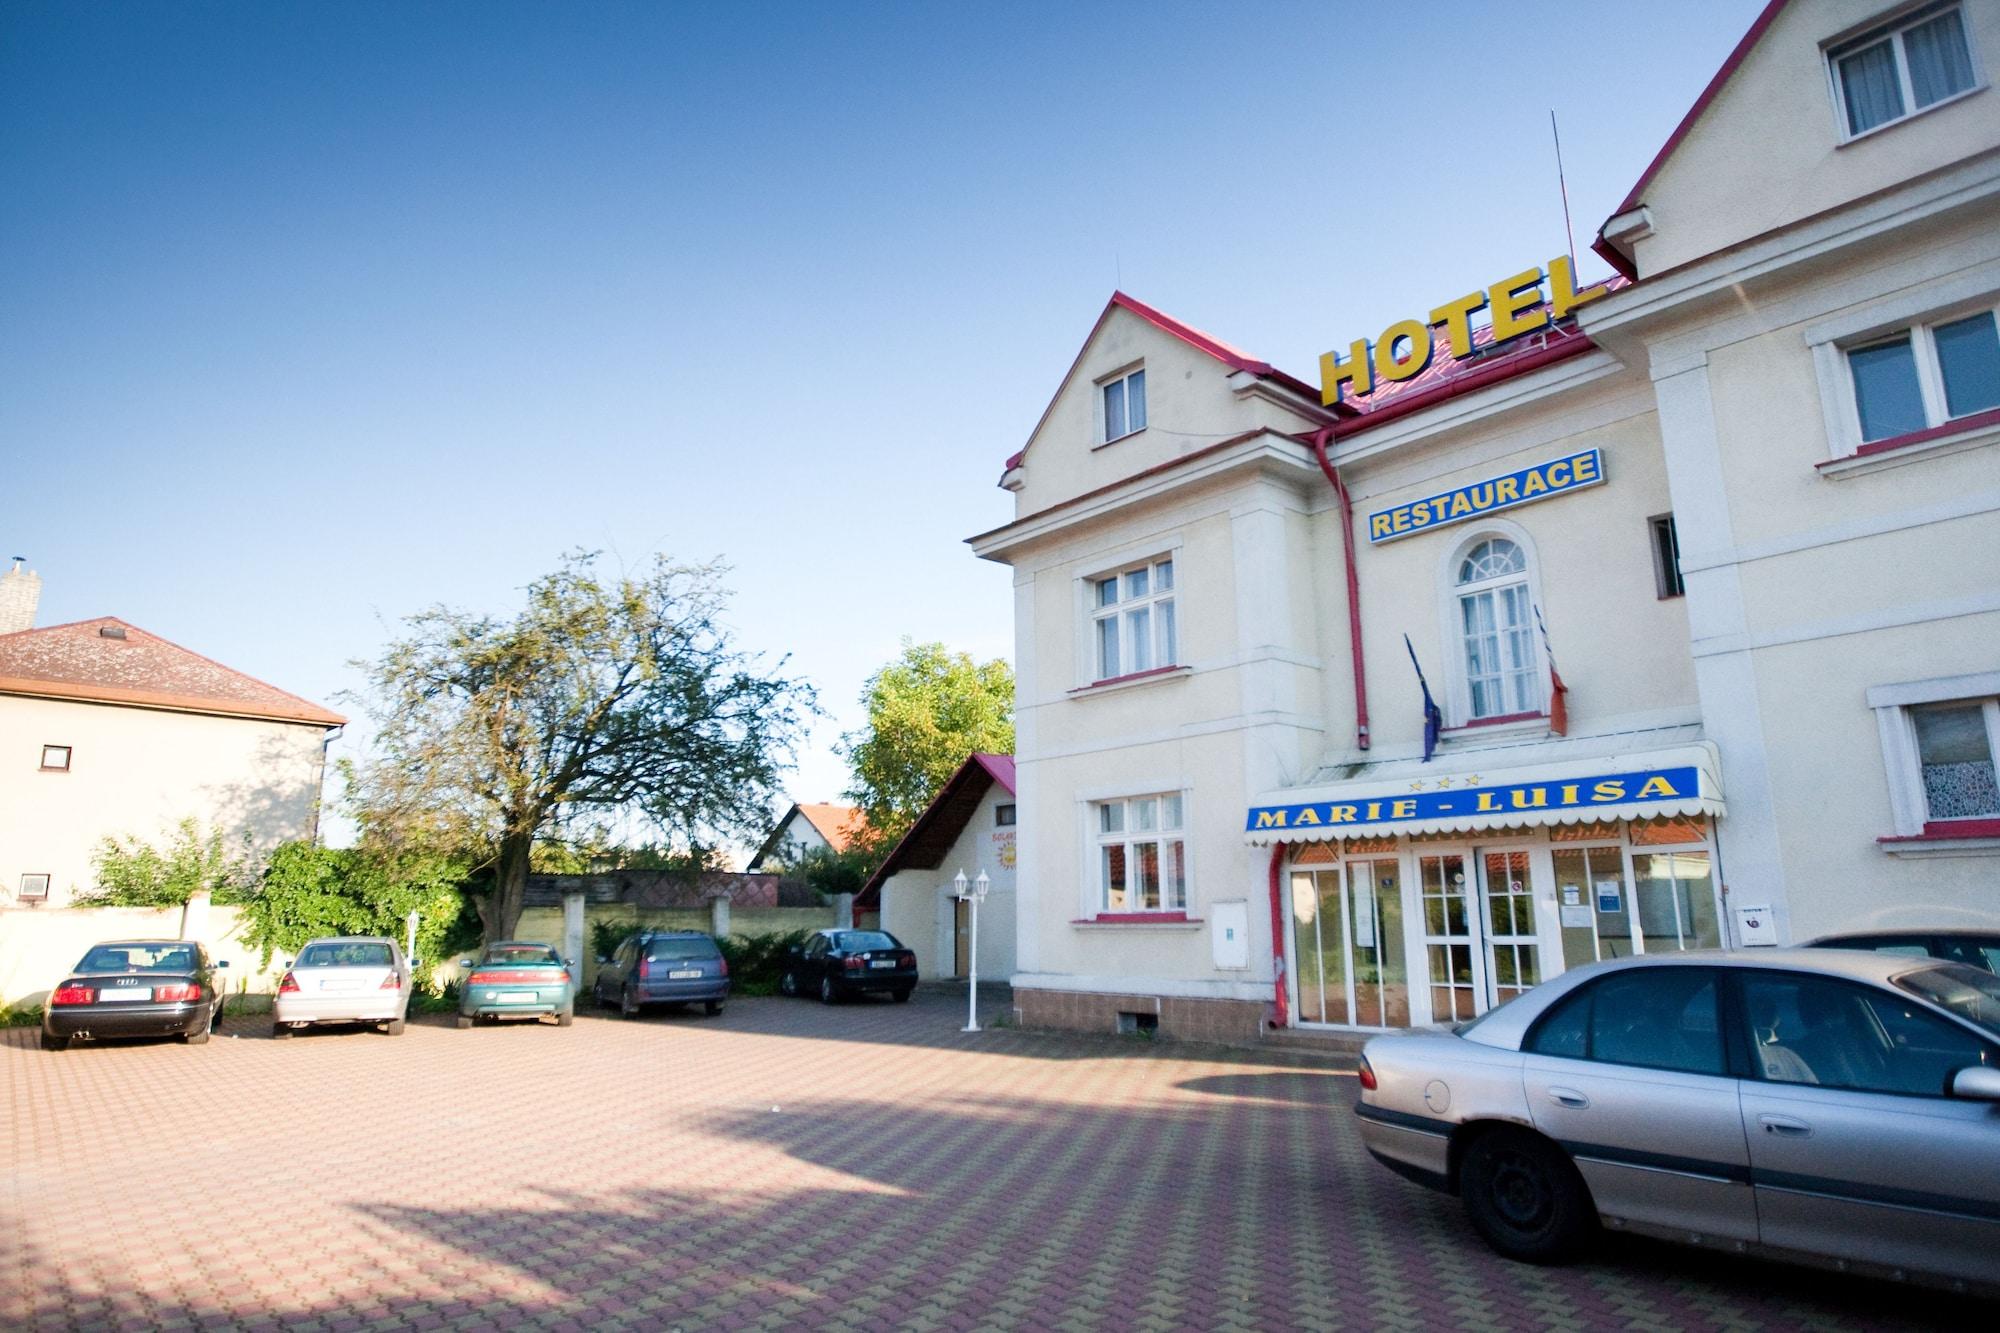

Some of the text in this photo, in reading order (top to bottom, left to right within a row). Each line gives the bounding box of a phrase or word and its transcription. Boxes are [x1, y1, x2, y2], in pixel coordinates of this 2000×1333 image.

[1319, 255, 1608, 407] HOTEL
[1371, 453, 1596, 538] RESTAURACE
[1255, 800, 1417, 830] MARIE
[1476, 775, 1680, 813] LUISA
